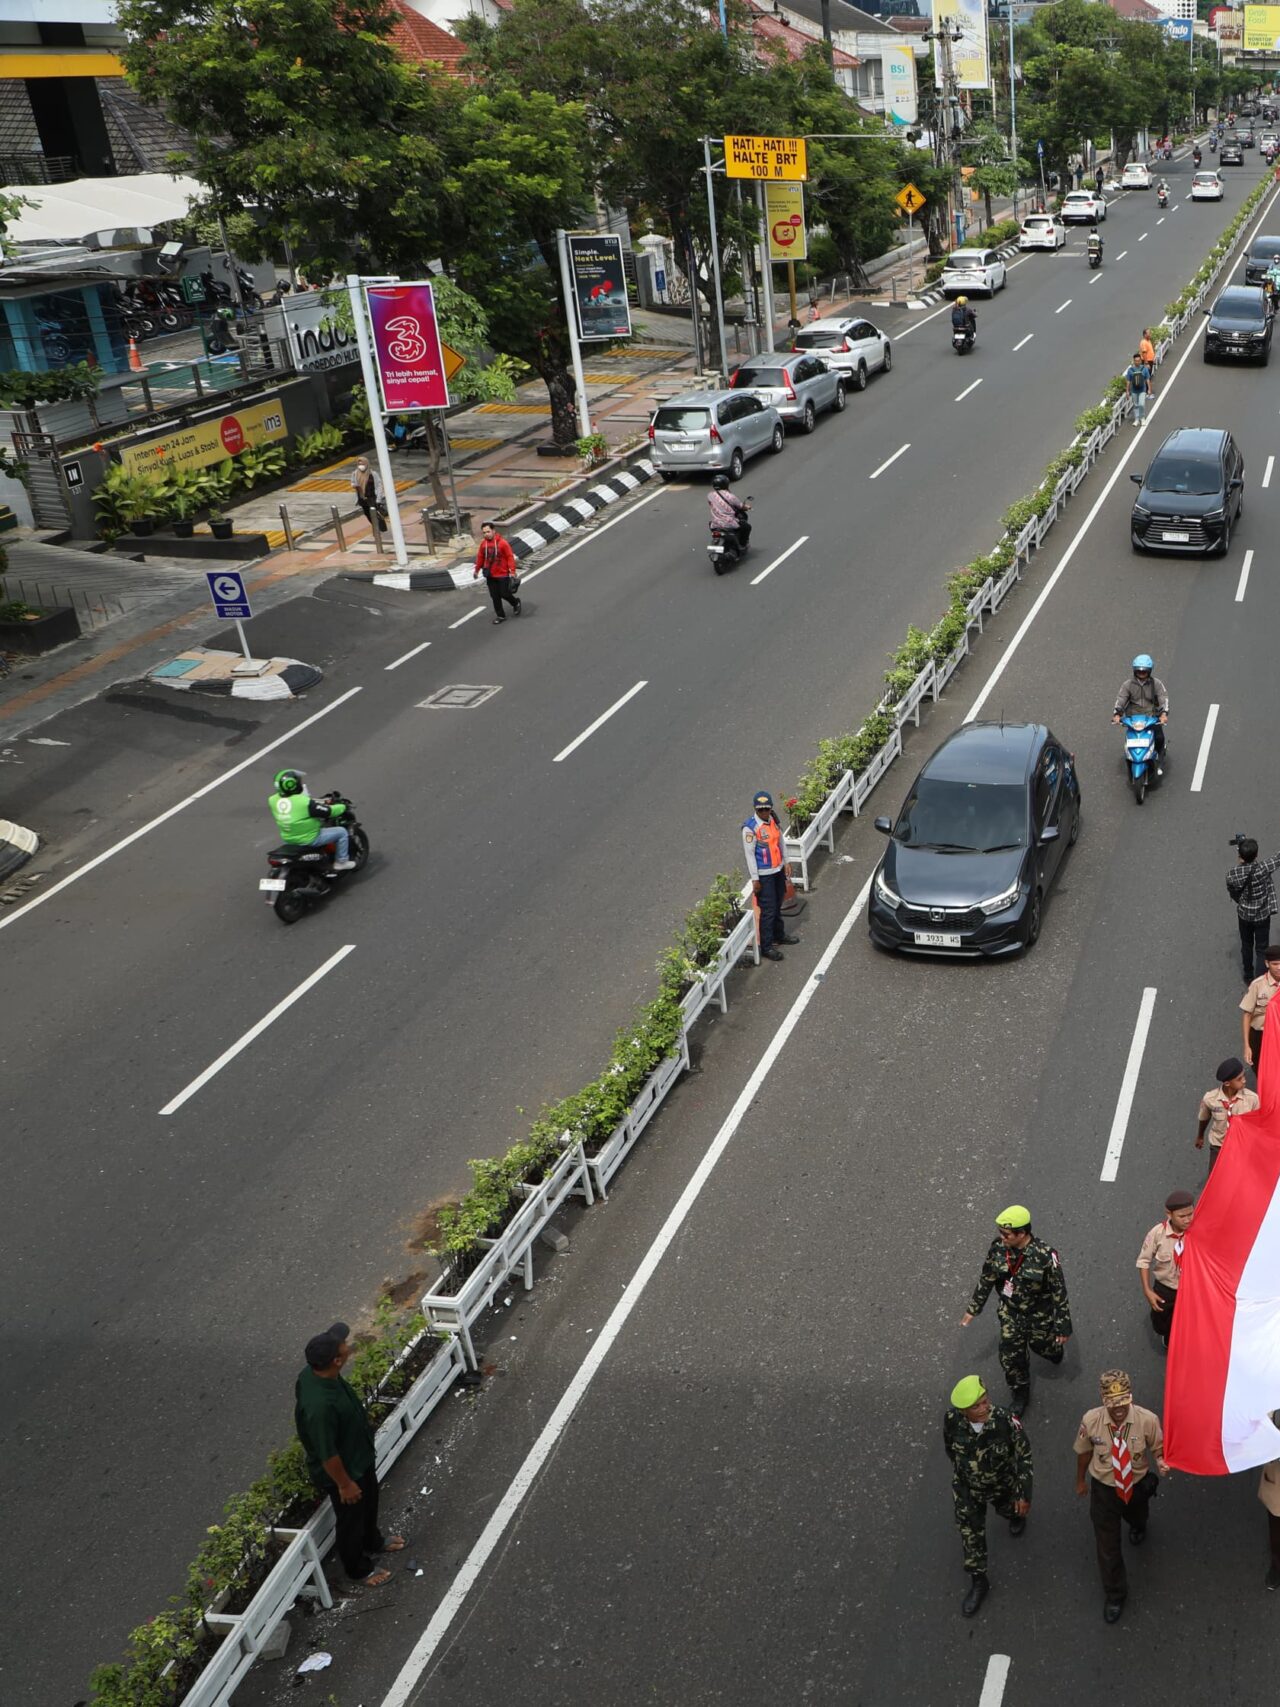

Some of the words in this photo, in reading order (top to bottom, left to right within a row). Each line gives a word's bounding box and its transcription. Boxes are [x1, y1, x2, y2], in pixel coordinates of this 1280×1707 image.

[732, 138, 755, 150] HATI
[763, 139, 786, 152] HATI
[788, 141, 798, 152] !!!
[733, 151, 768, 164] HALTE
[776, 153, 797, 165] BRT
[750, 165, 768, 177] 100
[774, 166, 783, 177] M
[574, 249, 600, 258] Simple.
[595, 254, 618, 262] Level.
[386, 377, 407, 385] sinyal
[408, 375, 430, 384] cepat!
[395, 370, 413, 378] lebih
[171, 438, 180, 448] 24
[180, 434, 196, 446] Jam
[137, 460, 160, 475] Sinyal
[178, 449, 194, 461] Luas
[194, 446, 200, 456] &
[200, 438, 219, 454] Stabil
